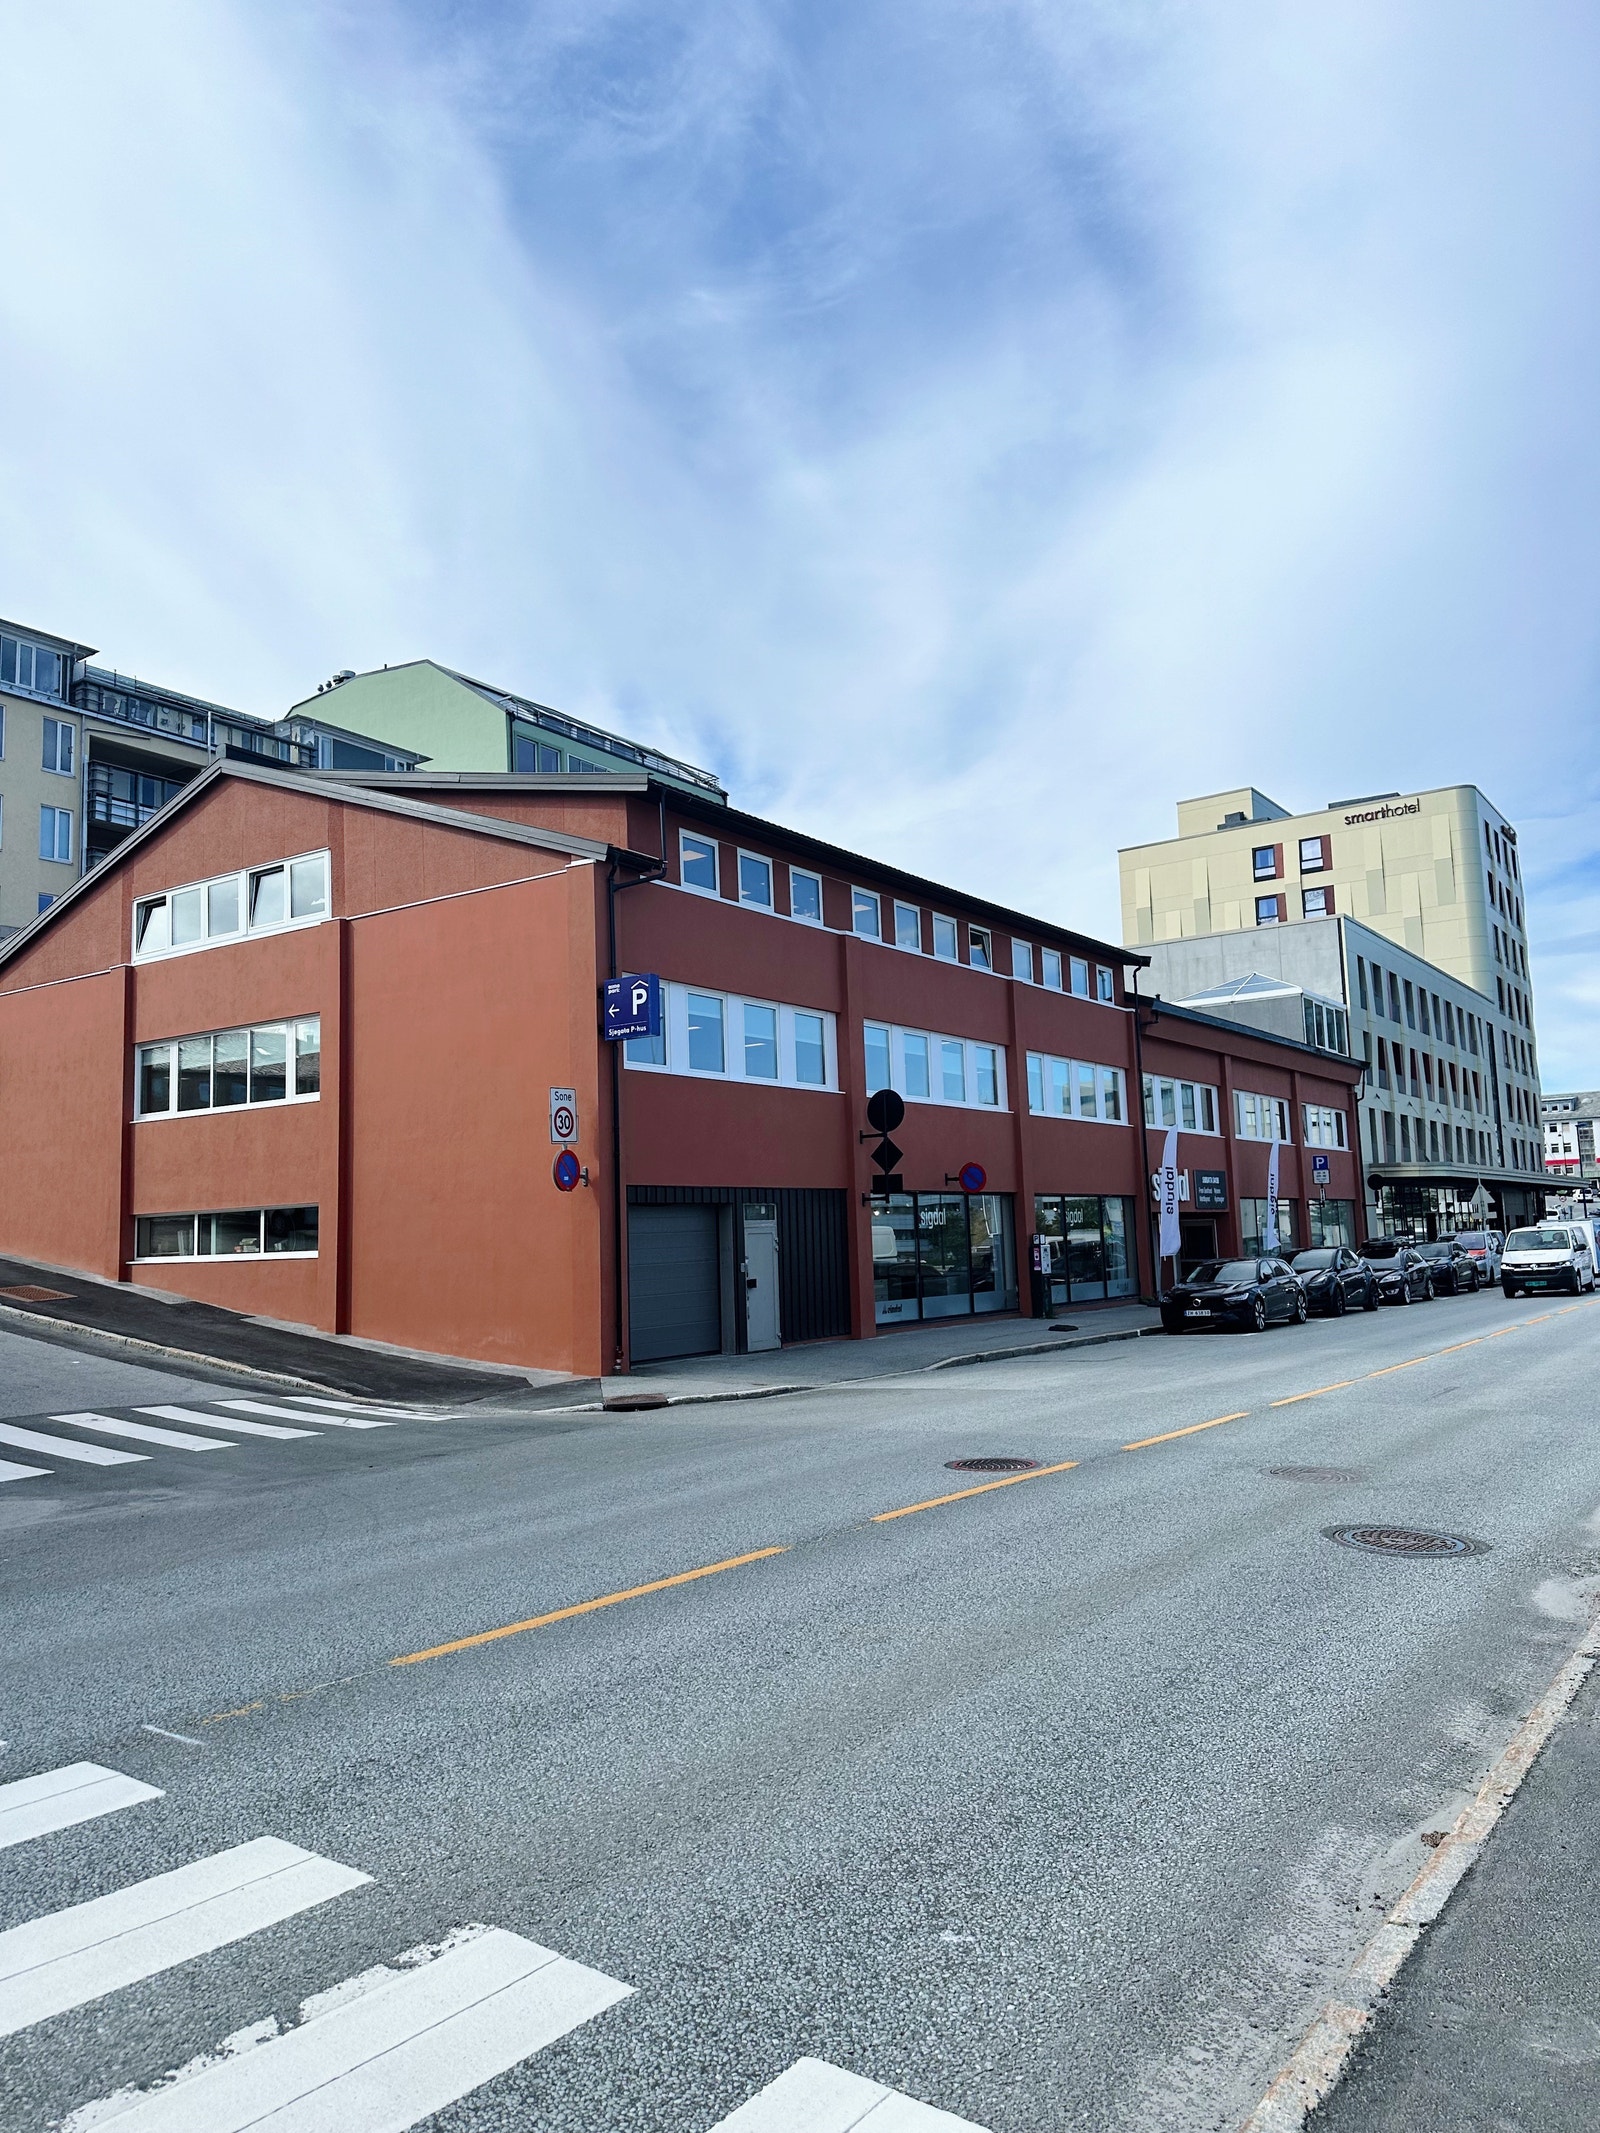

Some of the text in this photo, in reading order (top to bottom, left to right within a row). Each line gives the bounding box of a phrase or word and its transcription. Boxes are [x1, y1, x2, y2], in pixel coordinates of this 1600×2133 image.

[1344, 797, 1420, 825] smarthotel
[632, 988, 648, 1016] P
[630, 1025, 647, 1033] P-hus
[554, 1090, 572, 1102] Sone
[558, 1114, 571, 1130] 30
[1316, 1157, 1325, 1169] P
[920, 1207, 946, 1230] sigdal
[1065, 1208, 1084, 1227] sigdal
